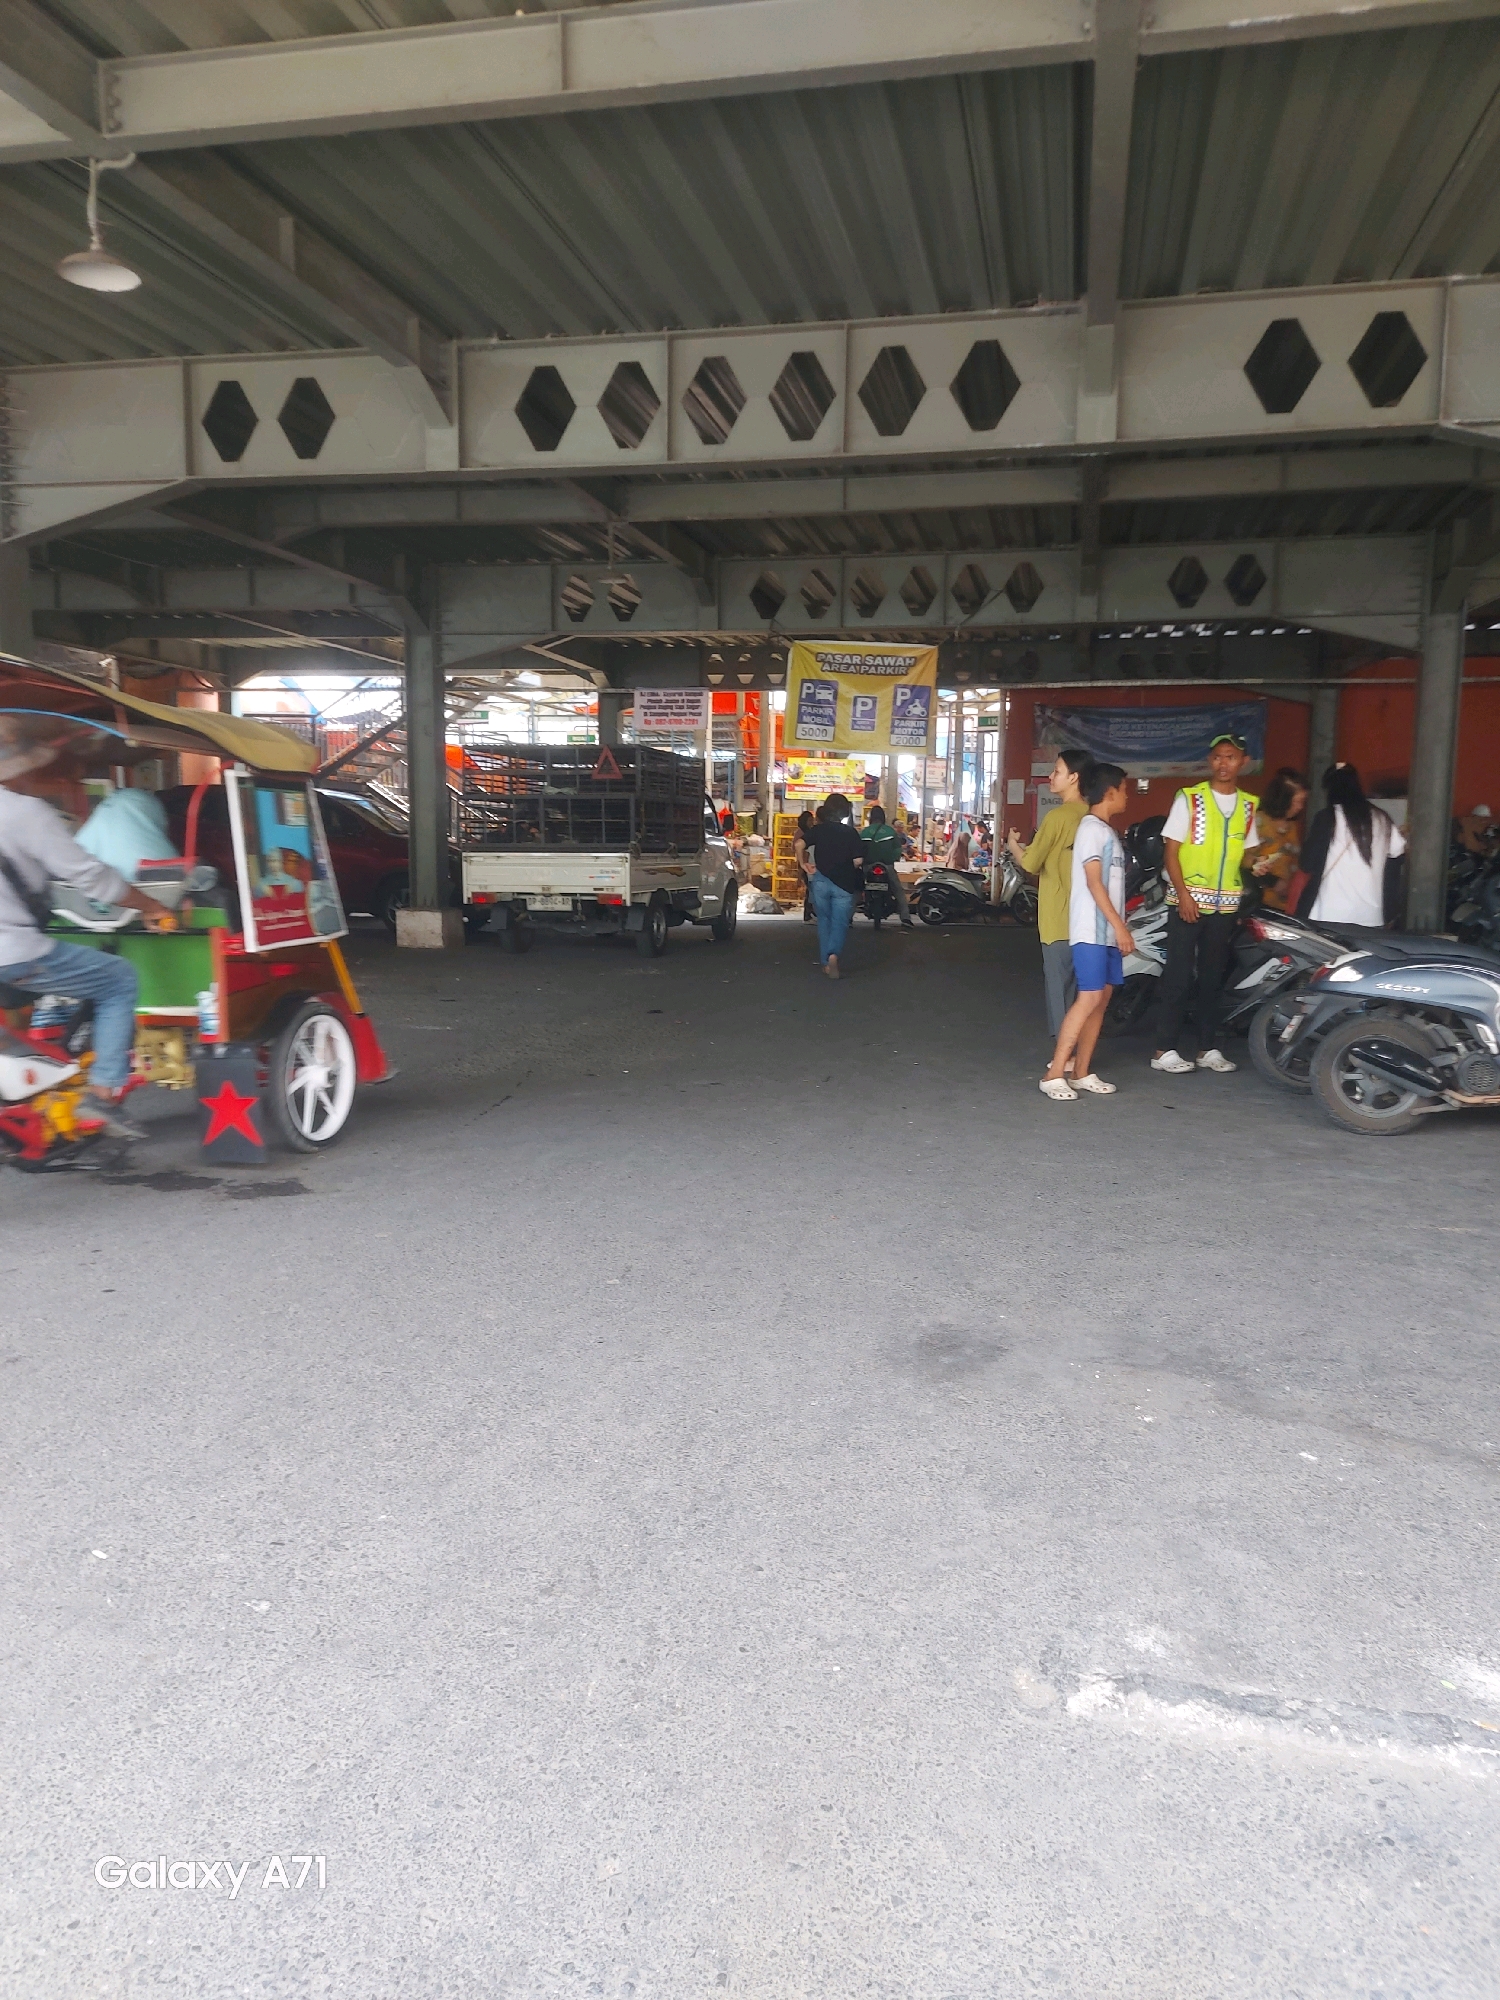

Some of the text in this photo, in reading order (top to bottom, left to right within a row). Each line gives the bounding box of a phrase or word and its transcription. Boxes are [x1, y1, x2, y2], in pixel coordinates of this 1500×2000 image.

[816, 653, 916, 666] PASAR SAWAH
[821, 663, 908, 675] AREA PARKIR
[801, 683, 815, 699] P
[896, 688, 911, 707] P
[801, 706, 834, 715] PARKIR
[855, 698, 873, 718] P
[802, 715, 831, 725] MOBIL
[894, 720, 926, 728] PARKIR
[800, 727, 828, 738] 5000
[893, 727, 925, 736] MOTOR
[895, 736, 921, 746] 2000
